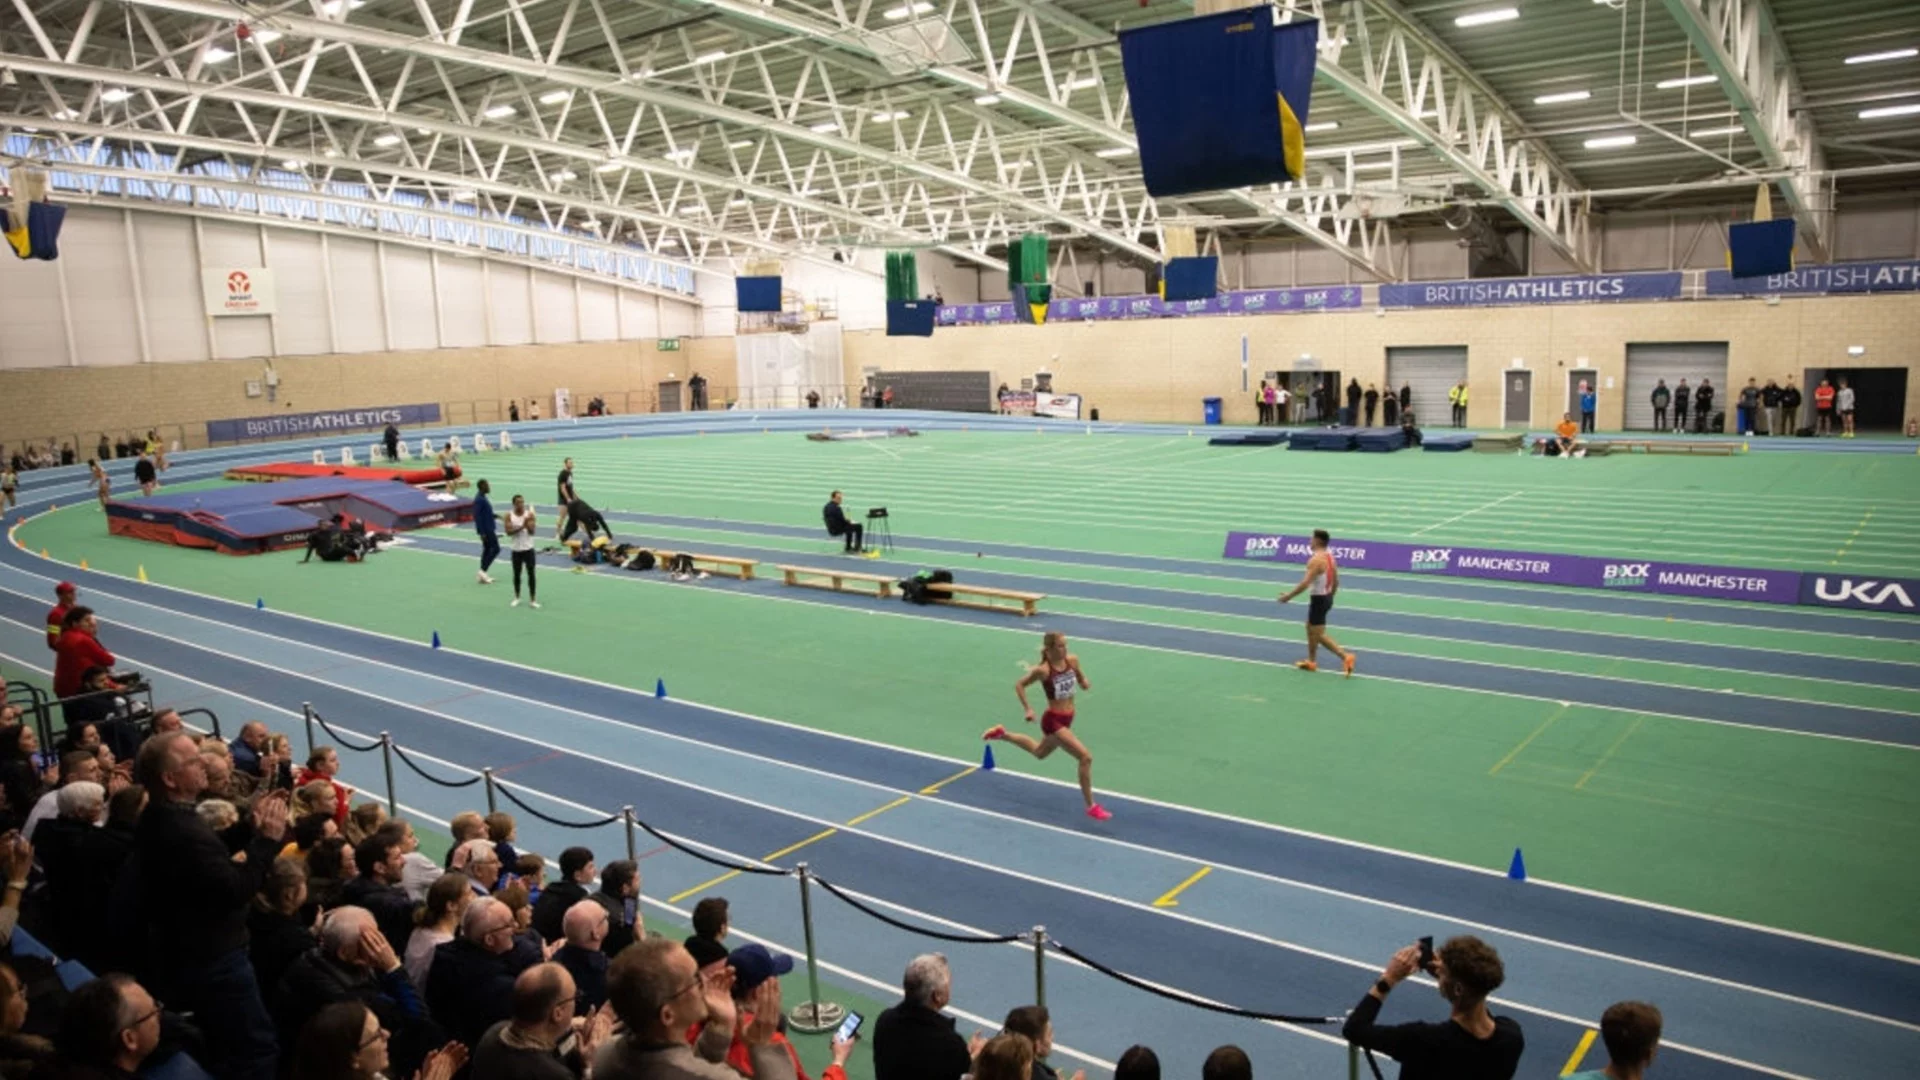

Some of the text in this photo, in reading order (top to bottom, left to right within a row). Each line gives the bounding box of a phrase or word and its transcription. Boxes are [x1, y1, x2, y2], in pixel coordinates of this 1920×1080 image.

[1767, 267, 1869, 289] BRITISH
[1425, 279, 1624, 301] BRITISH ATHLETICS
[247, 409, 402, 436] BRITISH ATHLETICS
[1285, 543, 1366, 560] MANESTER
[1457, 555, 1550, 573] MANCHESTER
[1658, 571, 1768, 591] MANCHESTER
[1815, 577, 1915, 607] UKA
